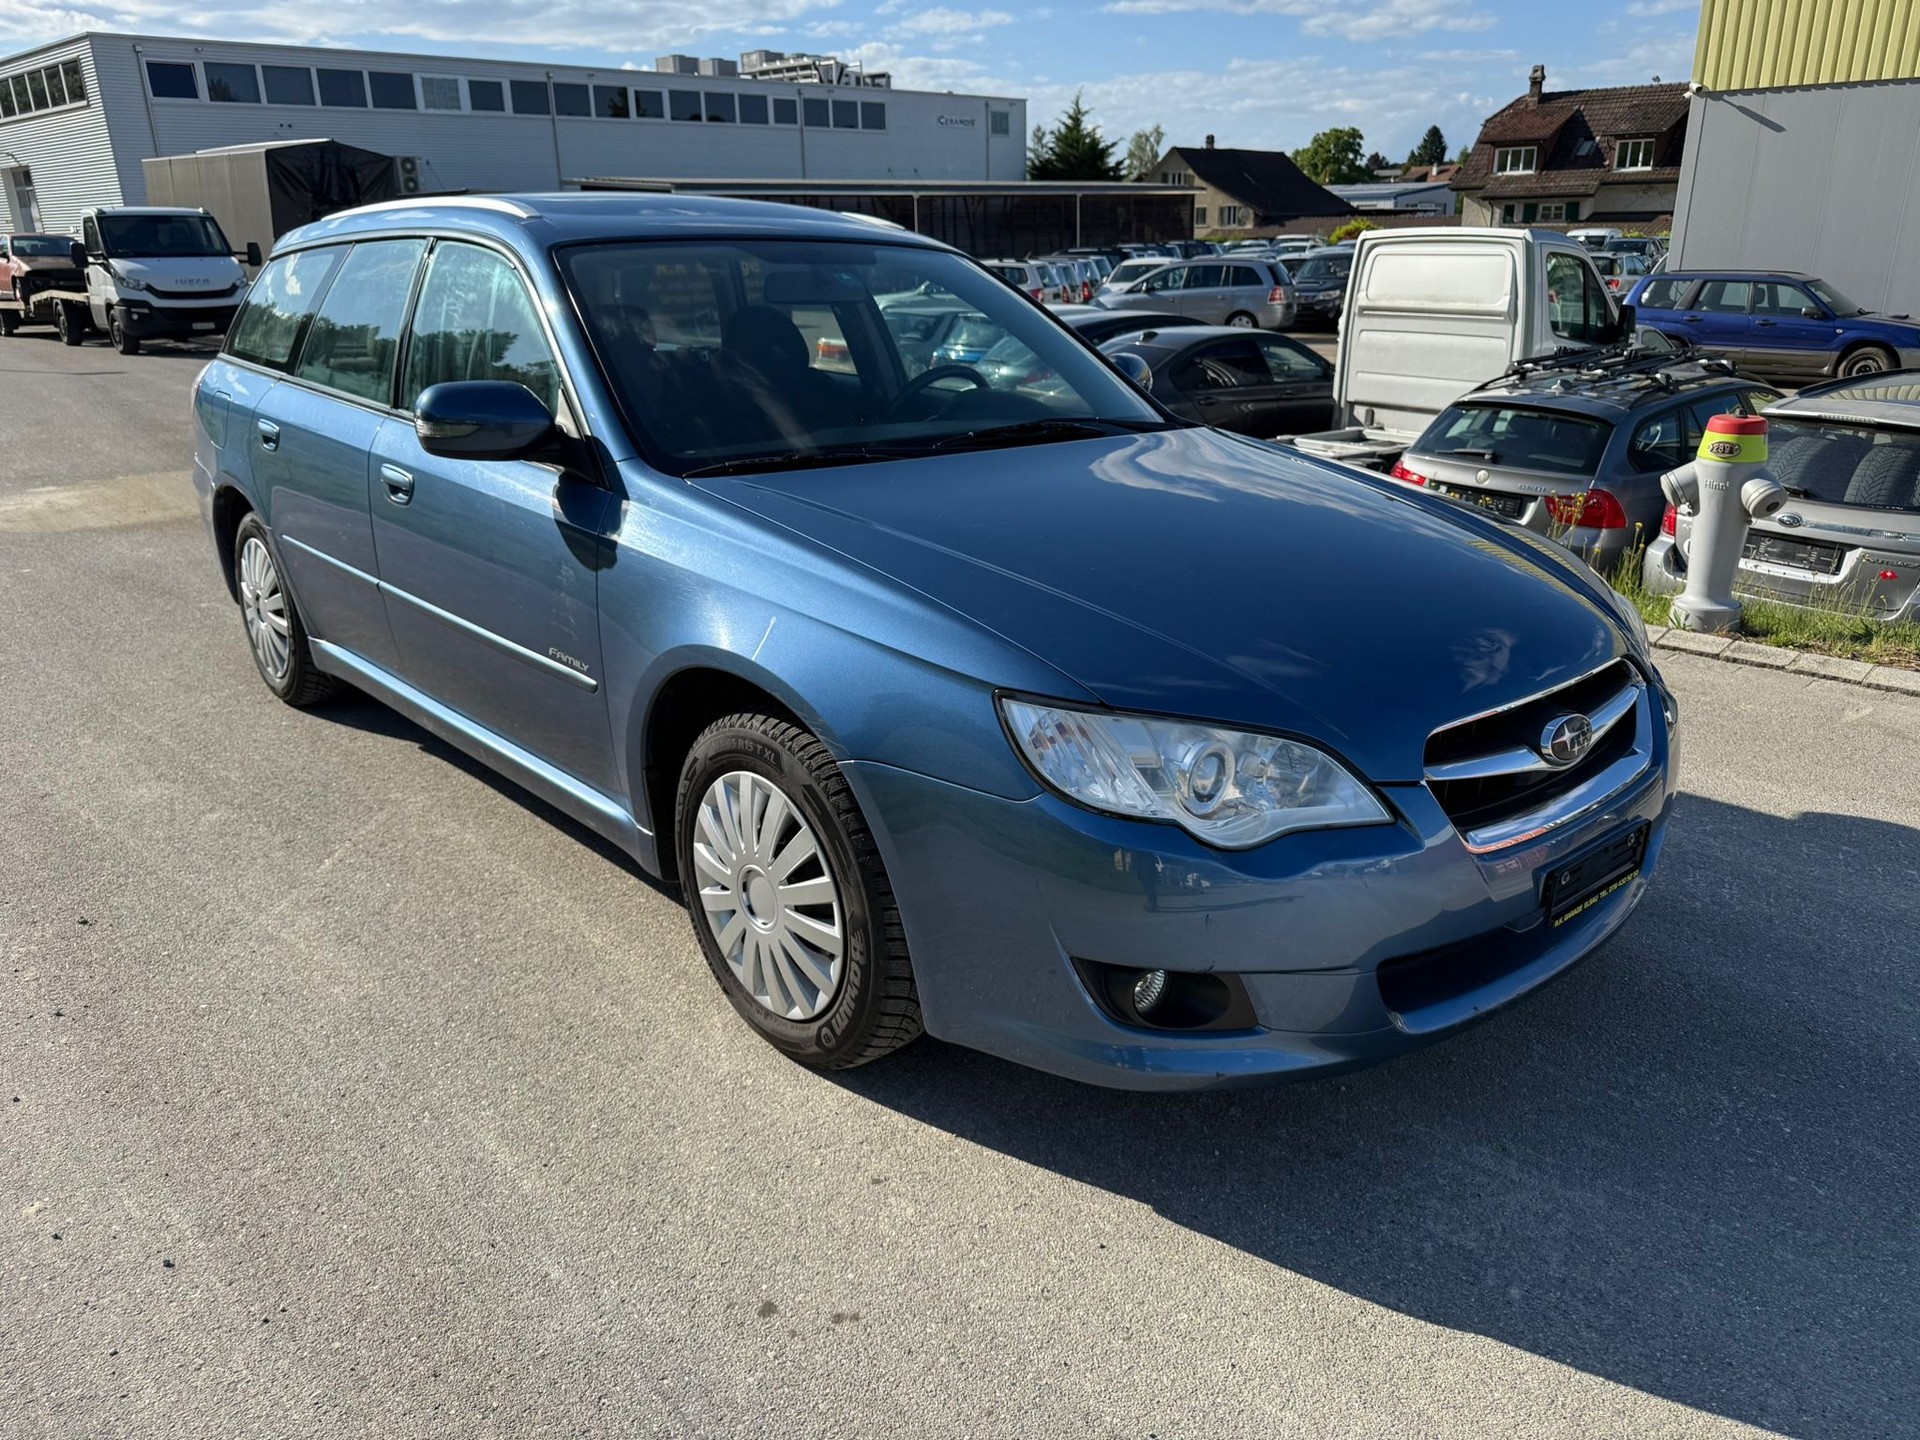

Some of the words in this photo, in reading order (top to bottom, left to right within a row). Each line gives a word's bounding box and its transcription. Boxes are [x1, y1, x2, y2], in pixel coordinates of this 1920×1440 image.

[174, 278, 211, 286] IVECO
[1713, 443, 1731, 454] 289
[738, 738, 754, 753] R15
[755, 744, 763, 754] T
[763, 748, 776, 765] XL
[830, 928, 867, 1037] Barum
